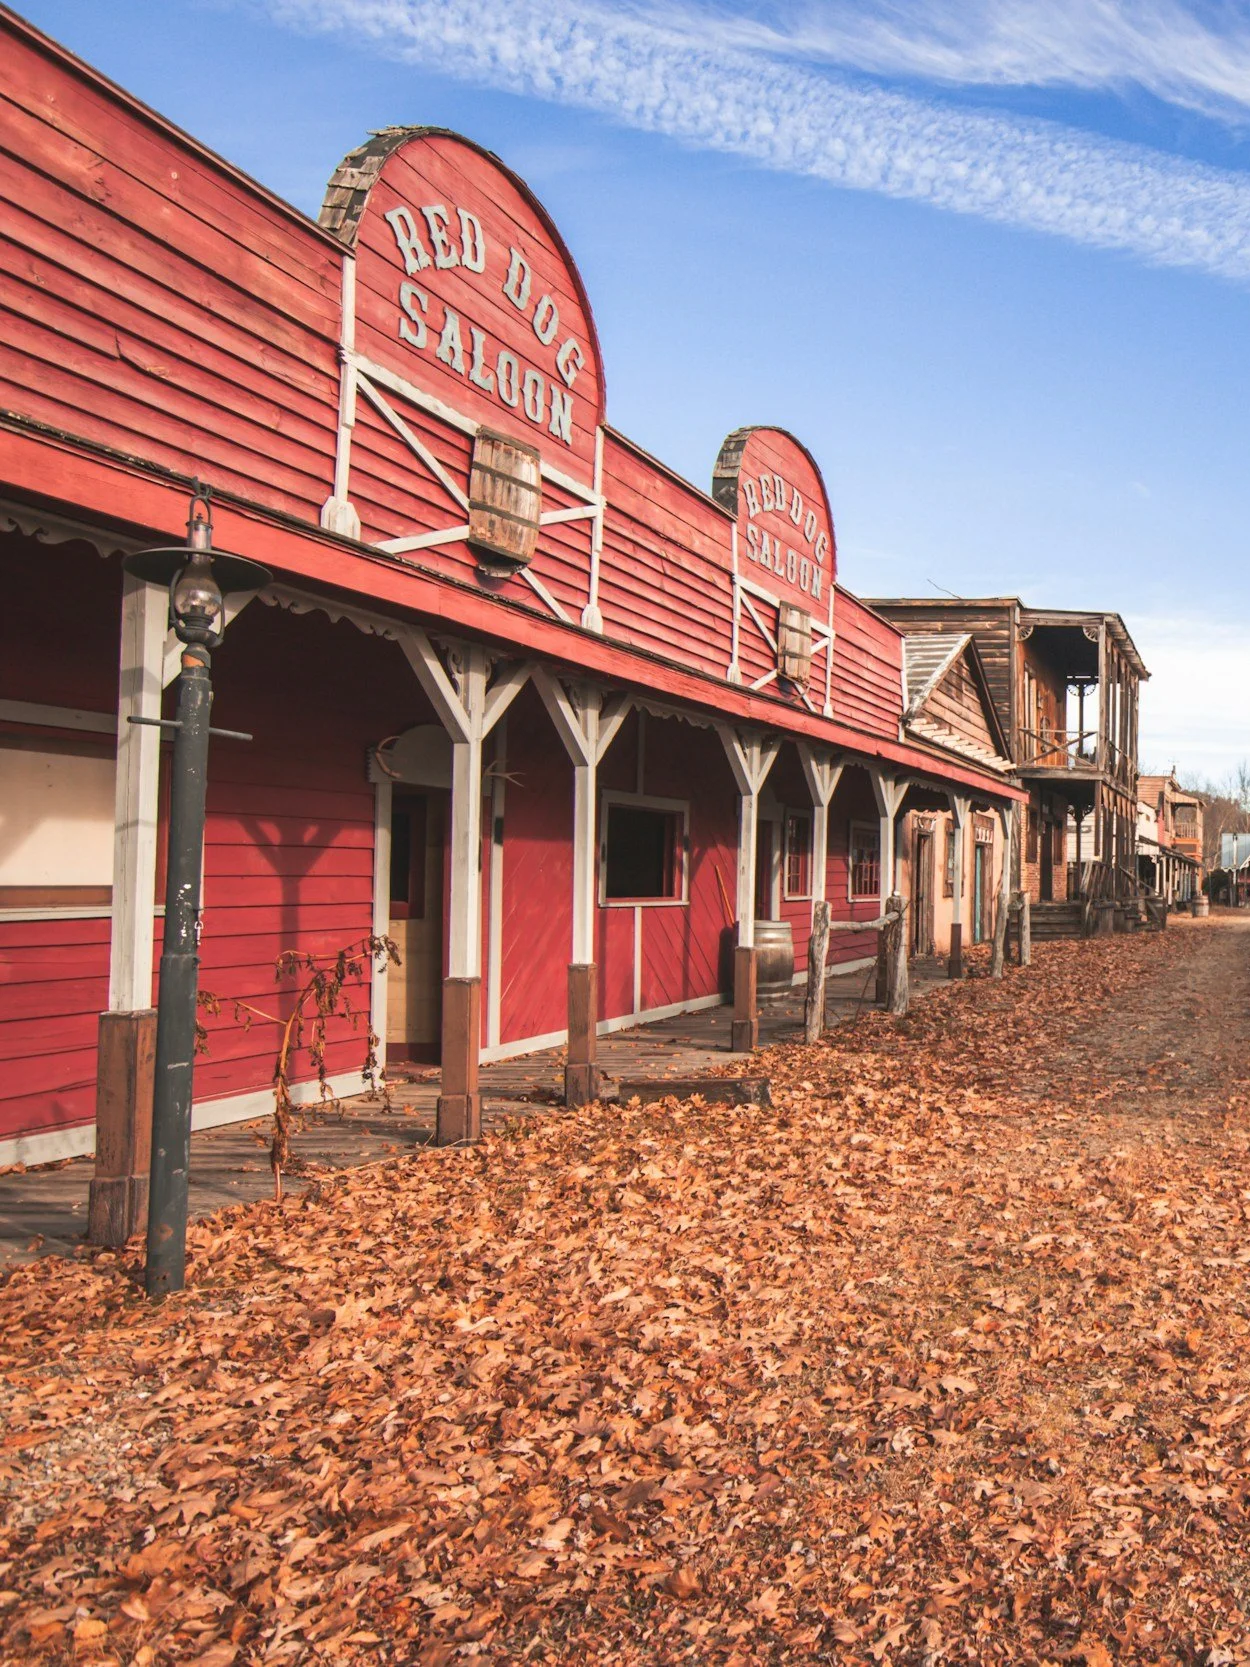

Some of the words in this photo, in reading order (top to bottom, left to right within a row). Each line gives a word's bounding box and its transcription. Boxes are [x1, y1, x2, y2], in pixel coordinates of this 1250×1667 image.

[384, 204, 486, 276] RED
[503, 246, 586, 388] DOG
[398, 281, 574, 446] SALOON
[742, 474, 786, 519] RED
[789, 487, 828, 564] DOG
[745, 522, 823, 600] SALOON
